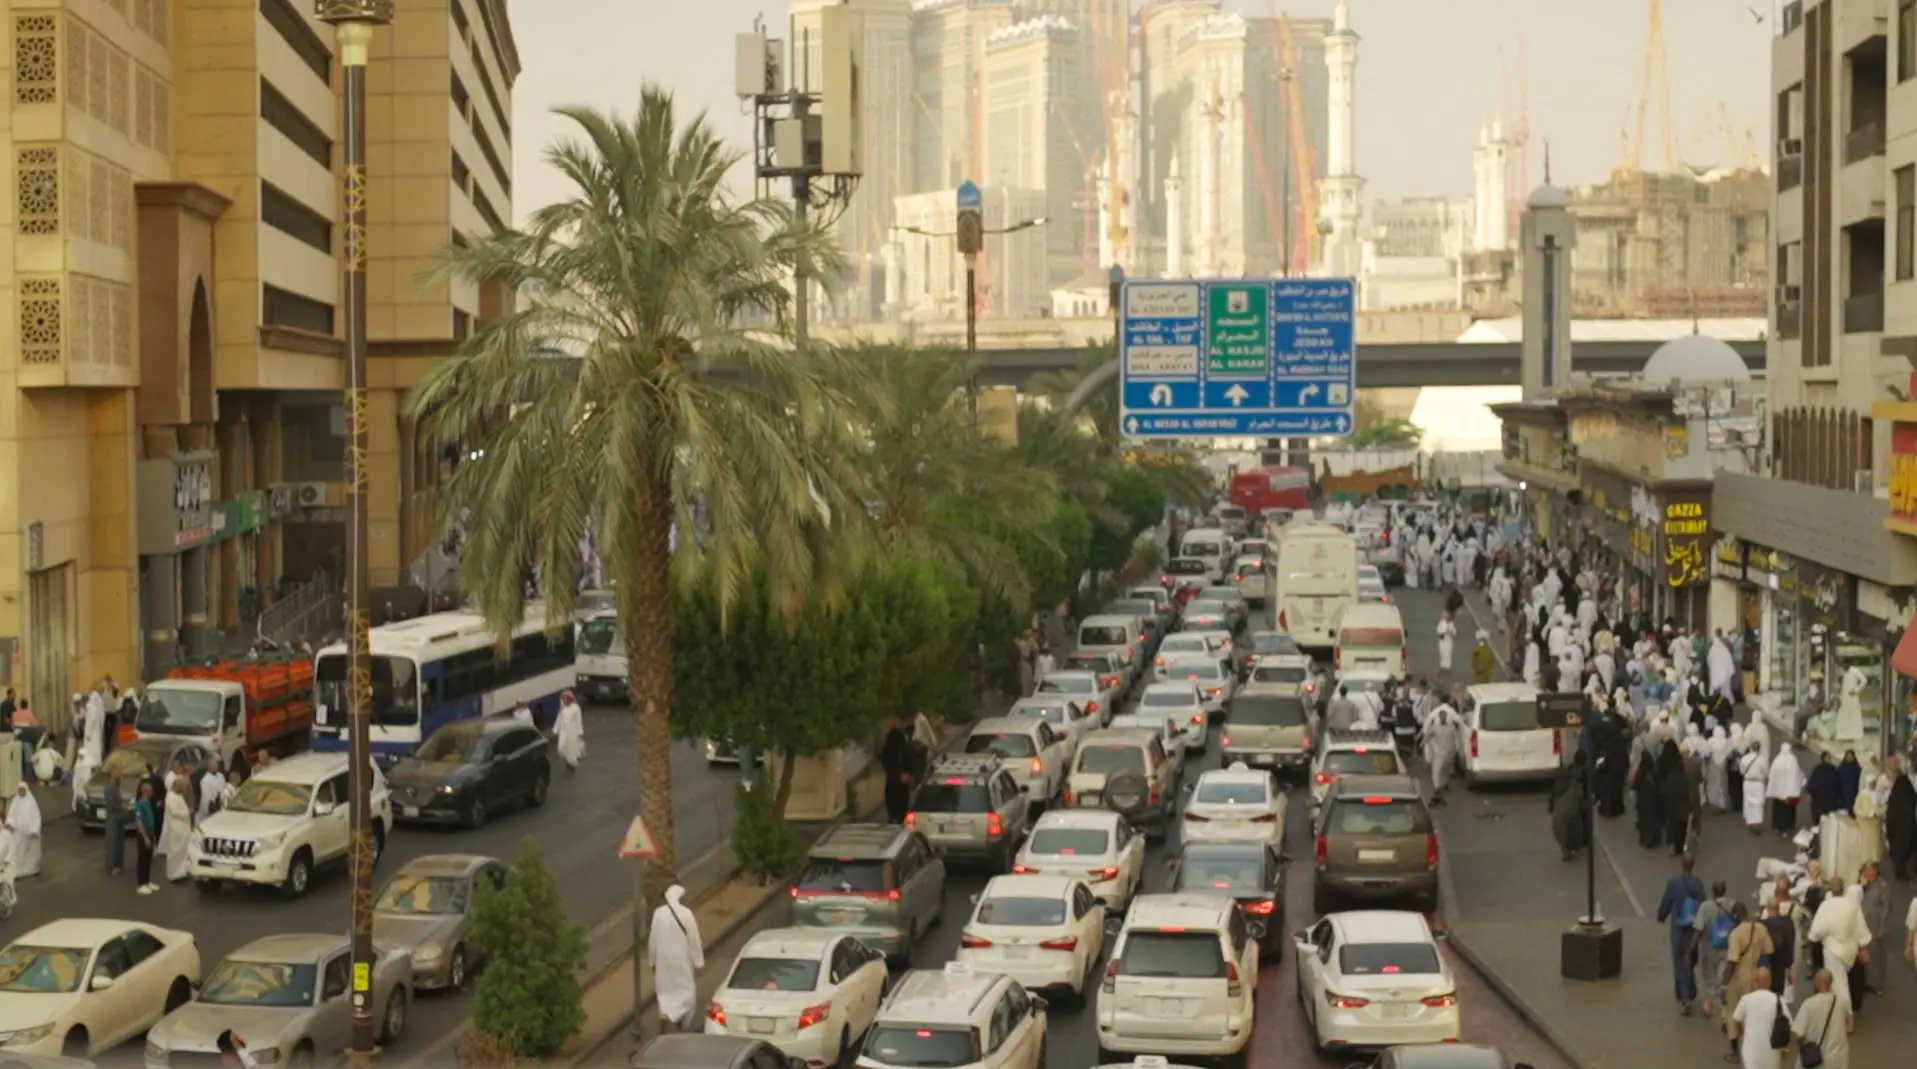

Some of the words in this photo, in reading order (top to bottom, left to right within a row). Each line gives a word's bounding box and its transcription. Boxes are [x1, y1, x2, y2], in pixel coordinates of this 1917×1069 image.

[1216, 314, 1260, 327] المسجد
[1216, 328, 1260, 344] الحرام
[1210, 345, 1224, 356] AL
[1210, 359, 1224, 369] AL
